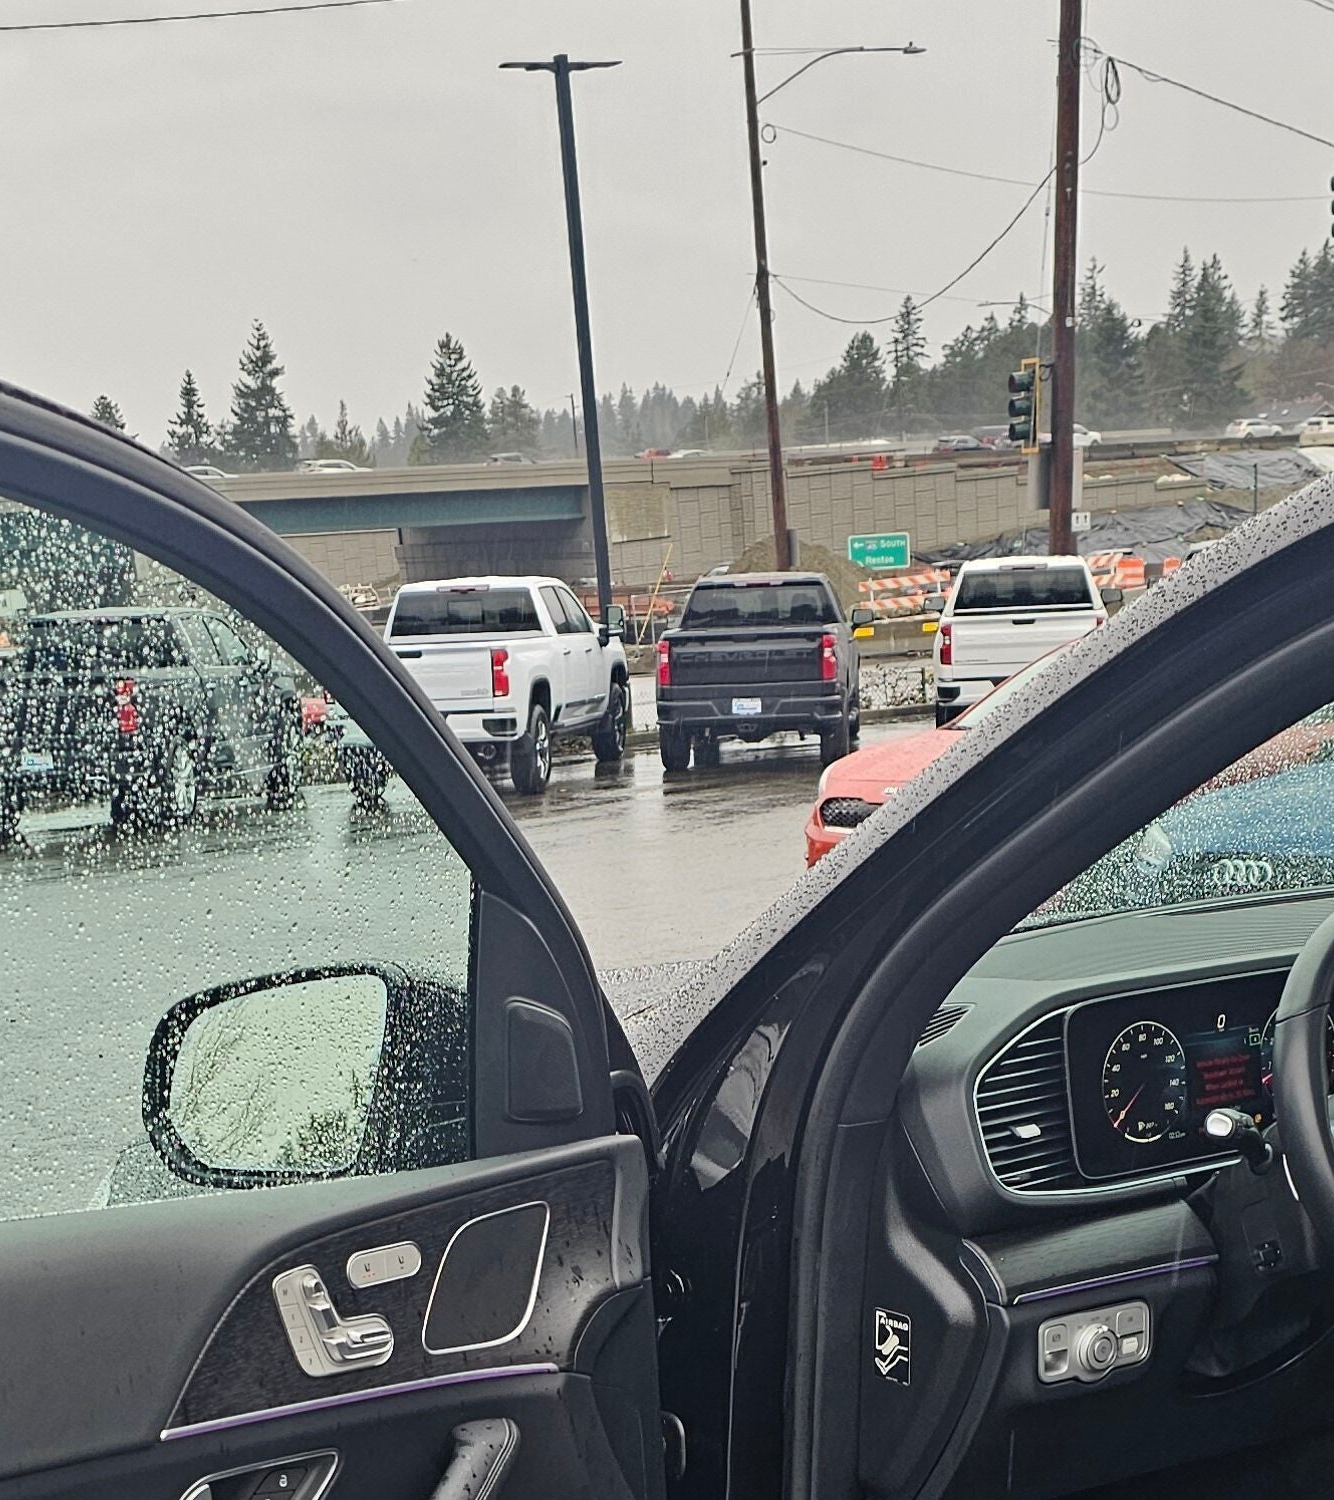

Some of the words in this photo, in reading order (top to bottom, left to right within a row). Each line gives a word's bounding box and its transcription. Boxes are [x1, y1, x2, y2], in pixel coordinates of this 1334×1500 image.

[1217, 1014, 1226, 1029] 0
[1110, 1089, 1120, 1097] 20
[879, 1316, 909, 1331] AIRBAG
